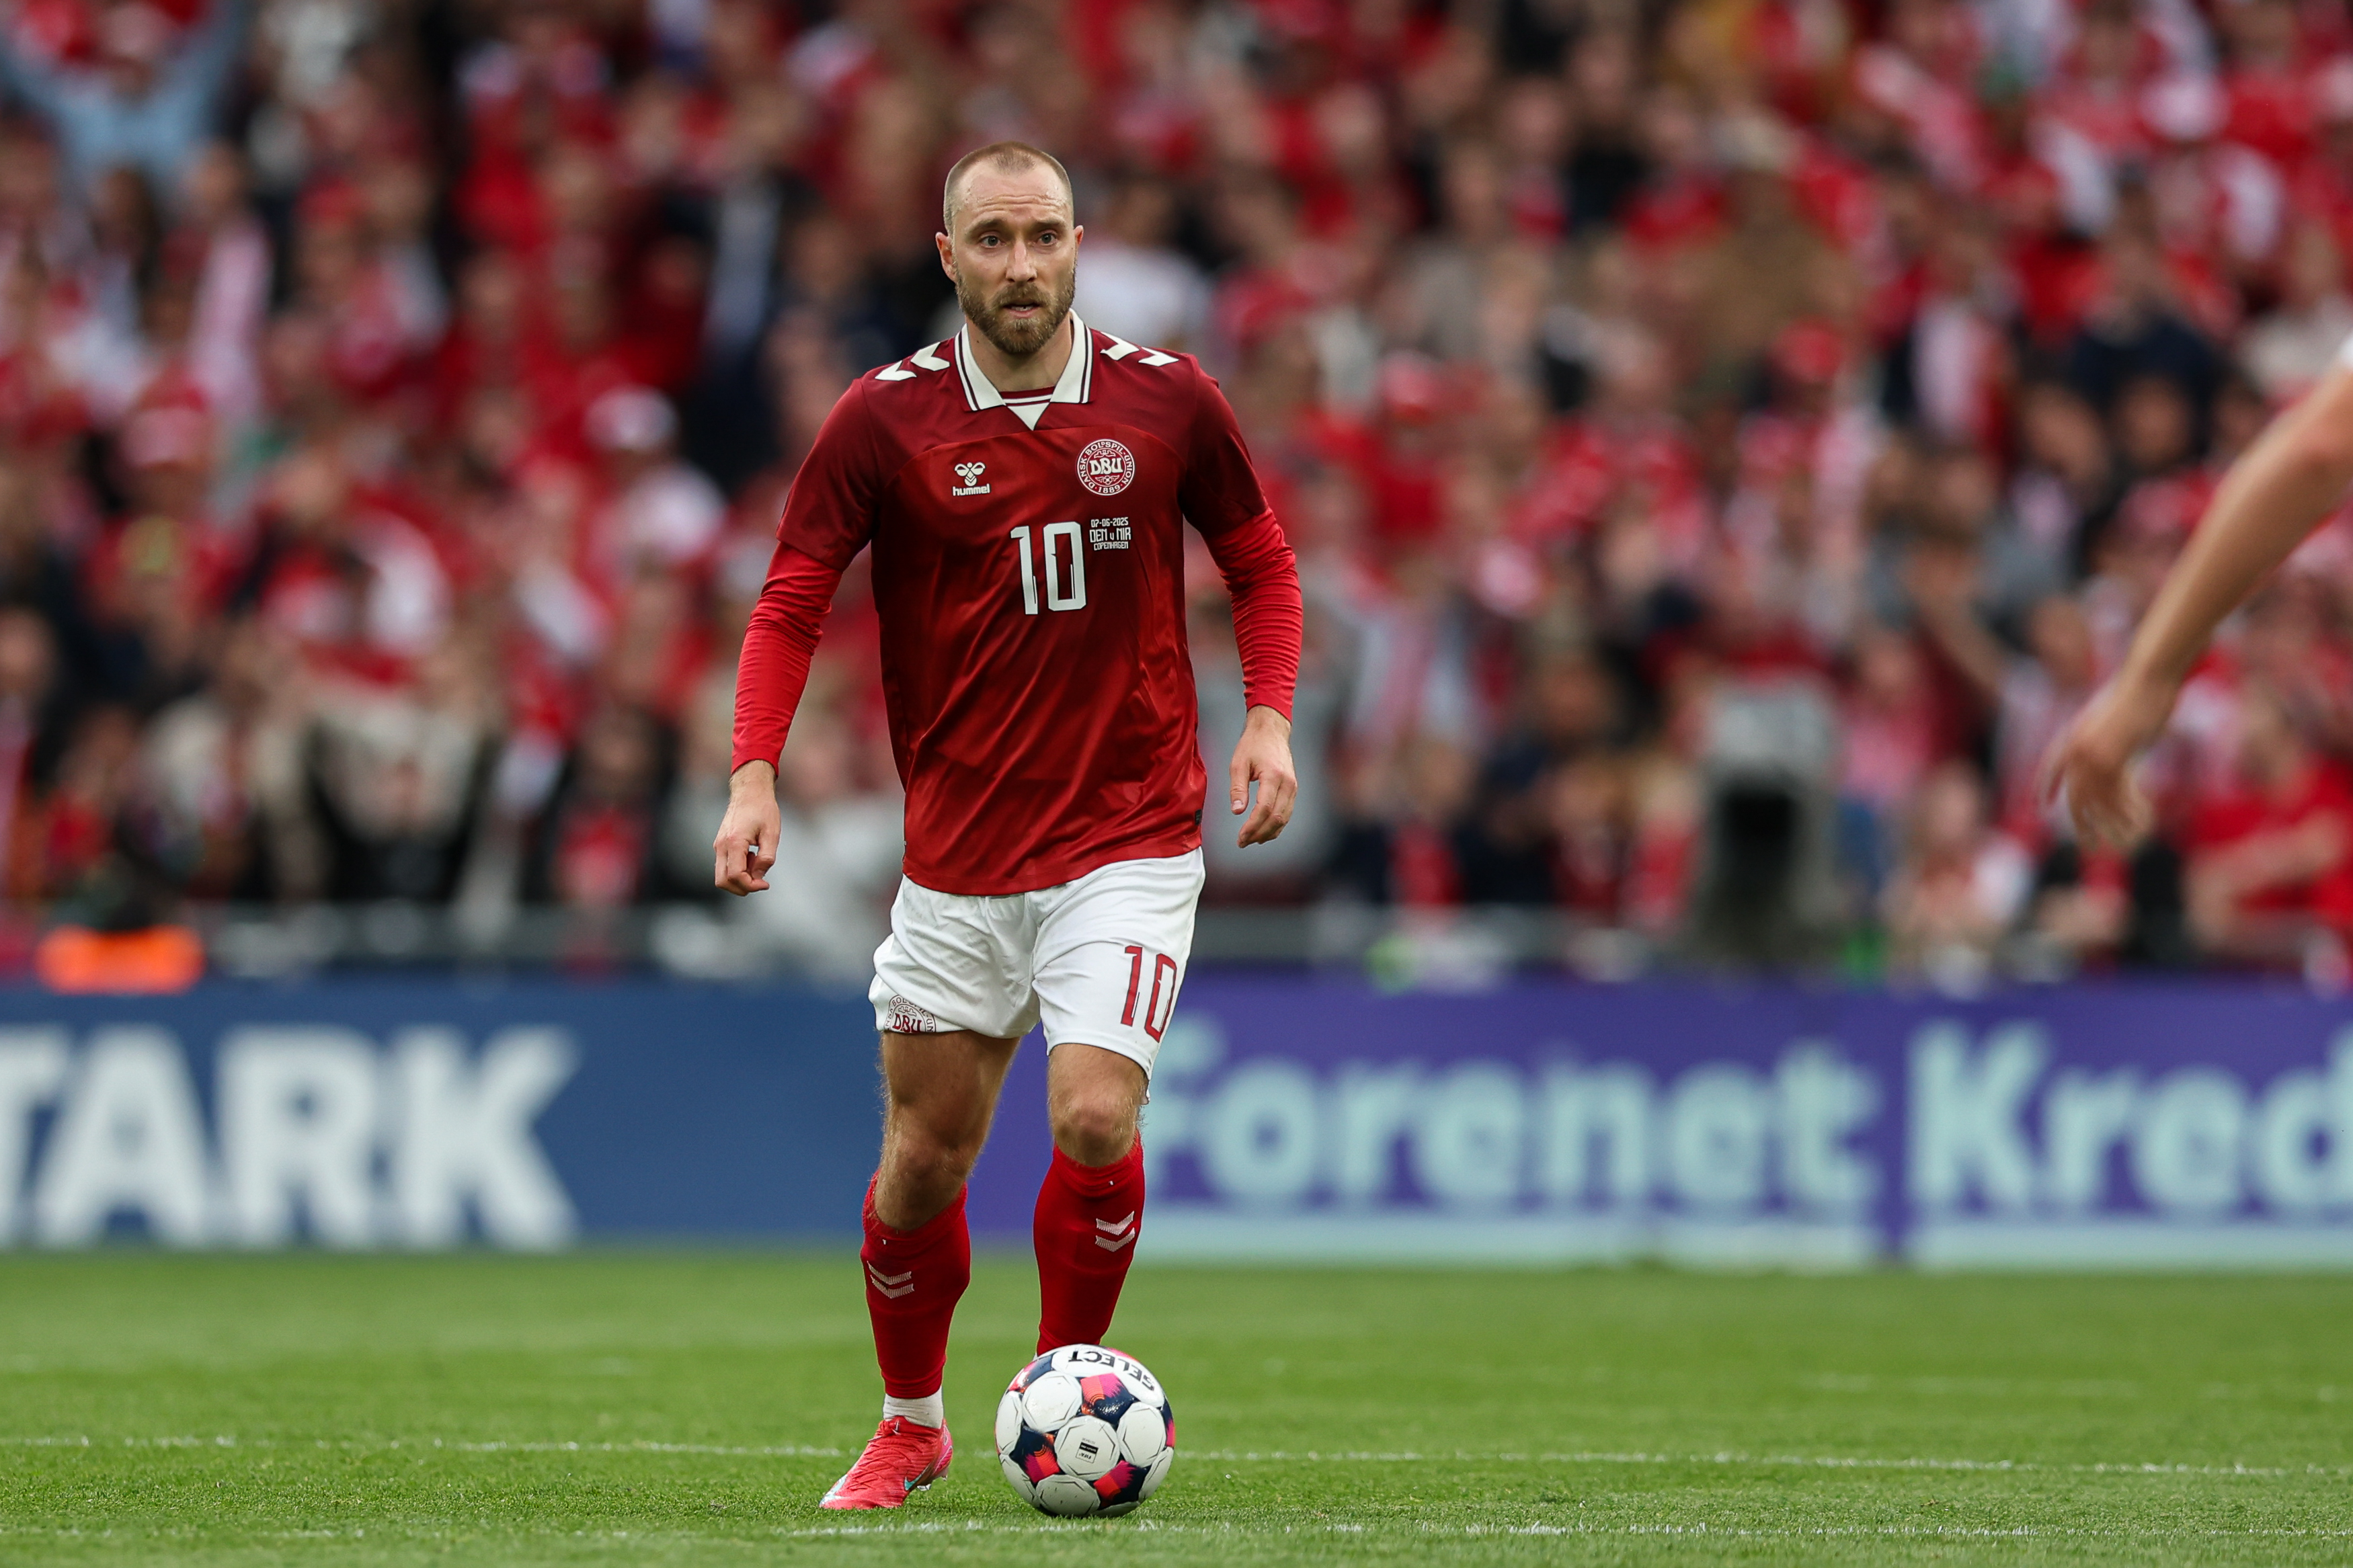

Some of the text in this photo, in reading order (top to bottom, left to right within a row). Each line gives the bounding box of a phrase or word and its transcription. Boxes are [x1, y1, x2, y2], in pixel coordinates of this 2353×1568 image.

[1080, 458, 1096, 489] DANSK
[1089, 458, 1123, 475] DBU
[953, 483, 990, 496] hummel
[1098, 485, 1121, 494] 1889
[1090, 516, 1129, 528] 07-06-2025
[1089, 528, 1108, 542] DEN
[1116, 527, 1131, 540] NIR
[1093, 541, 1129, 550] COPENHAGEN
[1010, 521, 1086, 615] 10
[1121, 945, 1177, 1043] 10
[892, 1013, 922, 1033] DBU
[1068, 1350, 1155, 1391] SELECT
